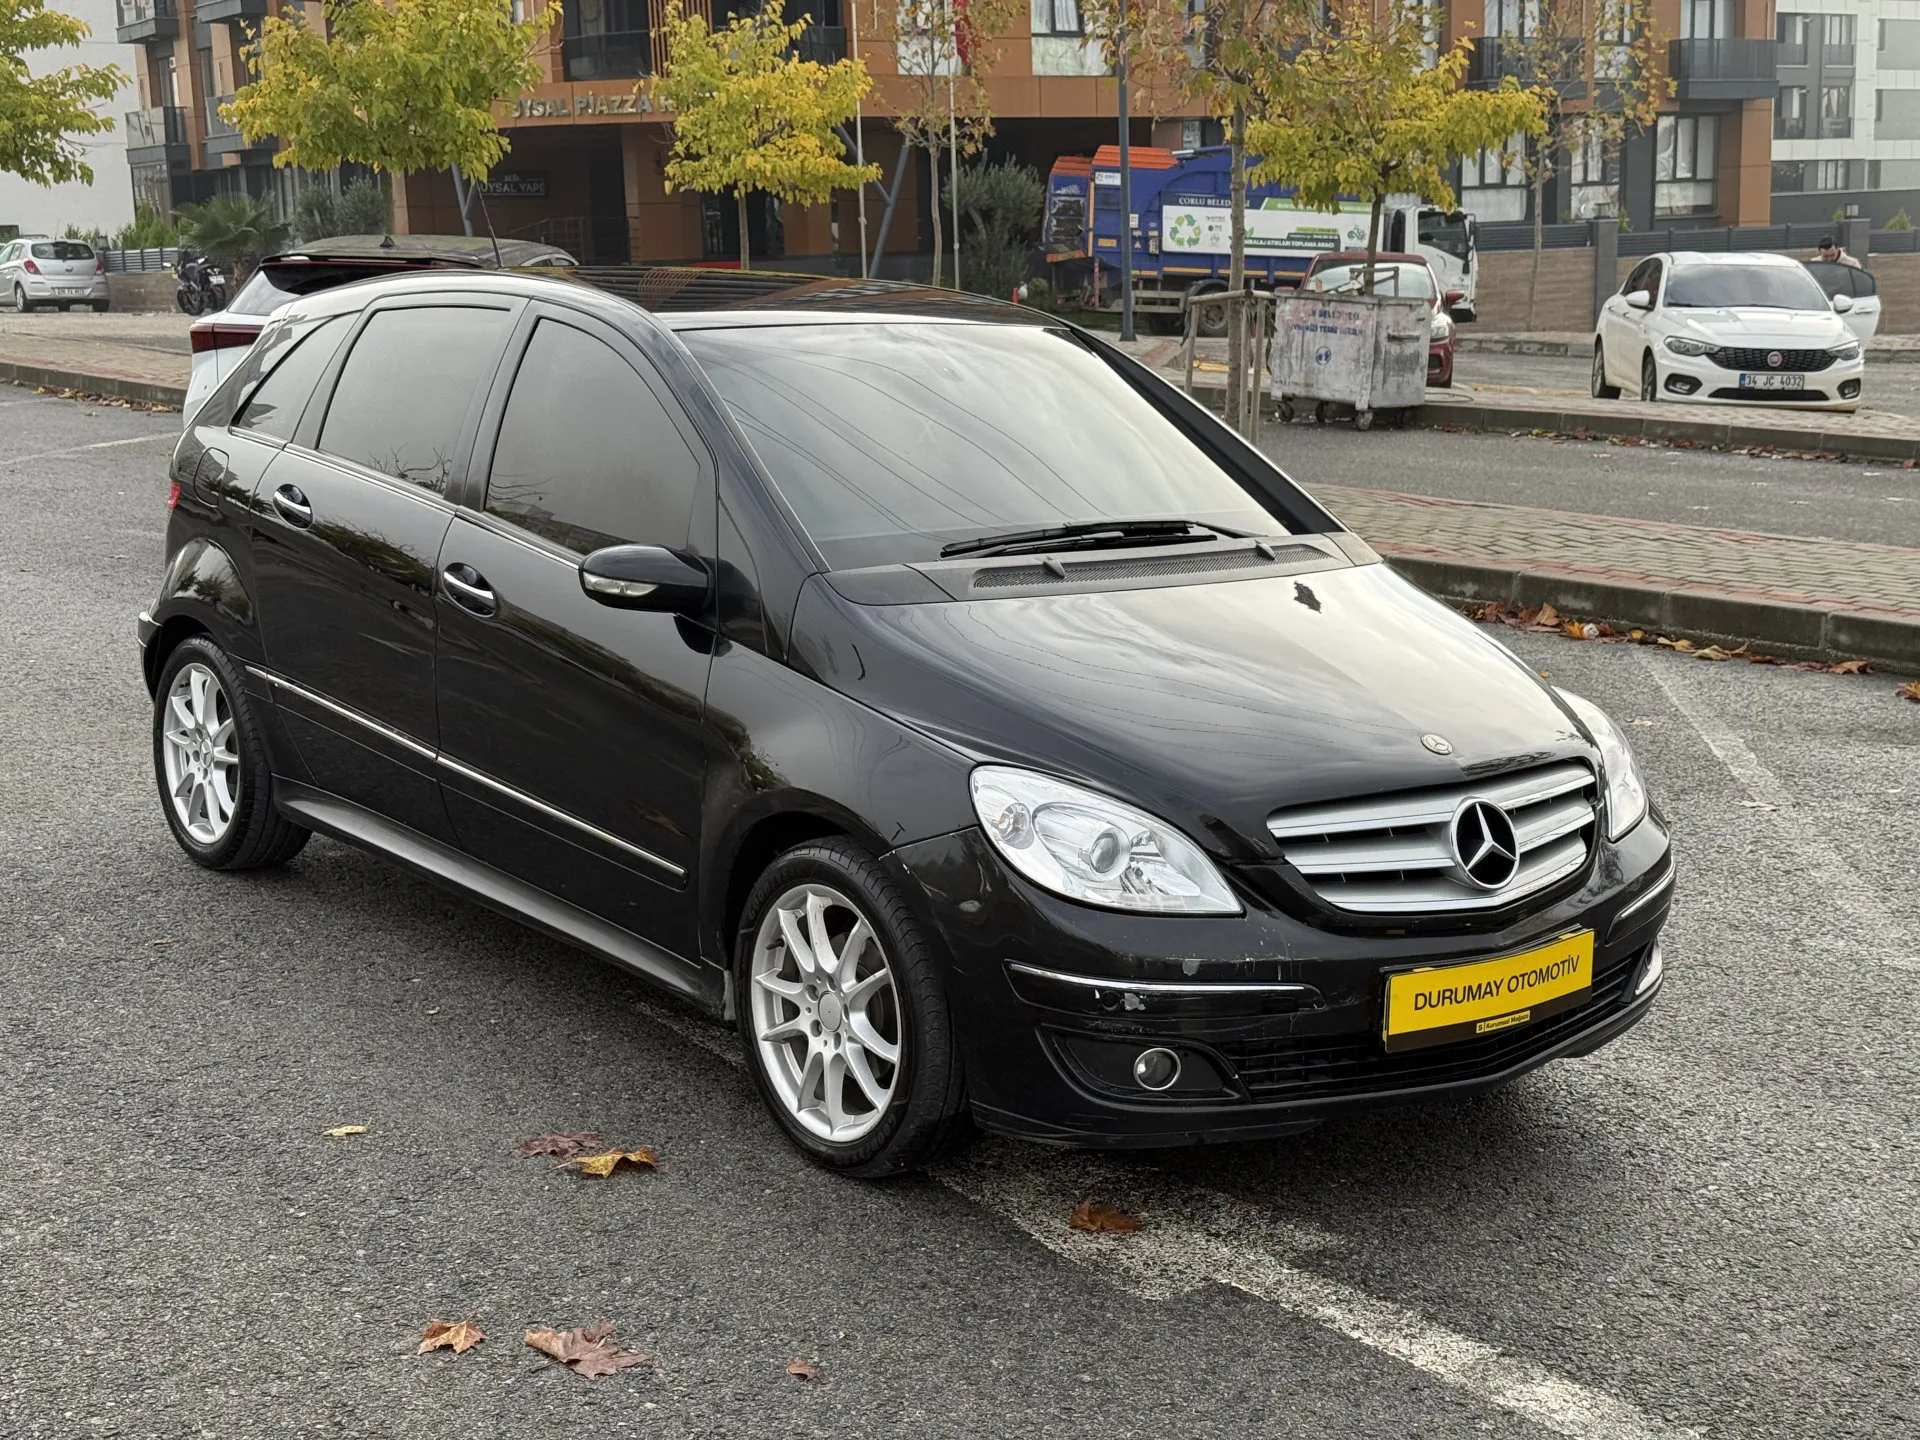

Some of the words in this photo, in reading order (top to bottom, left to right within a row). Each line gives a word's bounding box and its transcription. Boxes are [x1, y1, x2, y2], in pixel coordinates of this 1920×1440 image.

[1746, 375, 1757, 385] 34
[1763, 375, 1774, 386] JC
[1780, 375, 1802, 387] 4032
[1414, 978, 1504, 1011] DURUMAY
[1507, 954, 1580, 994] OTOMOTİV
